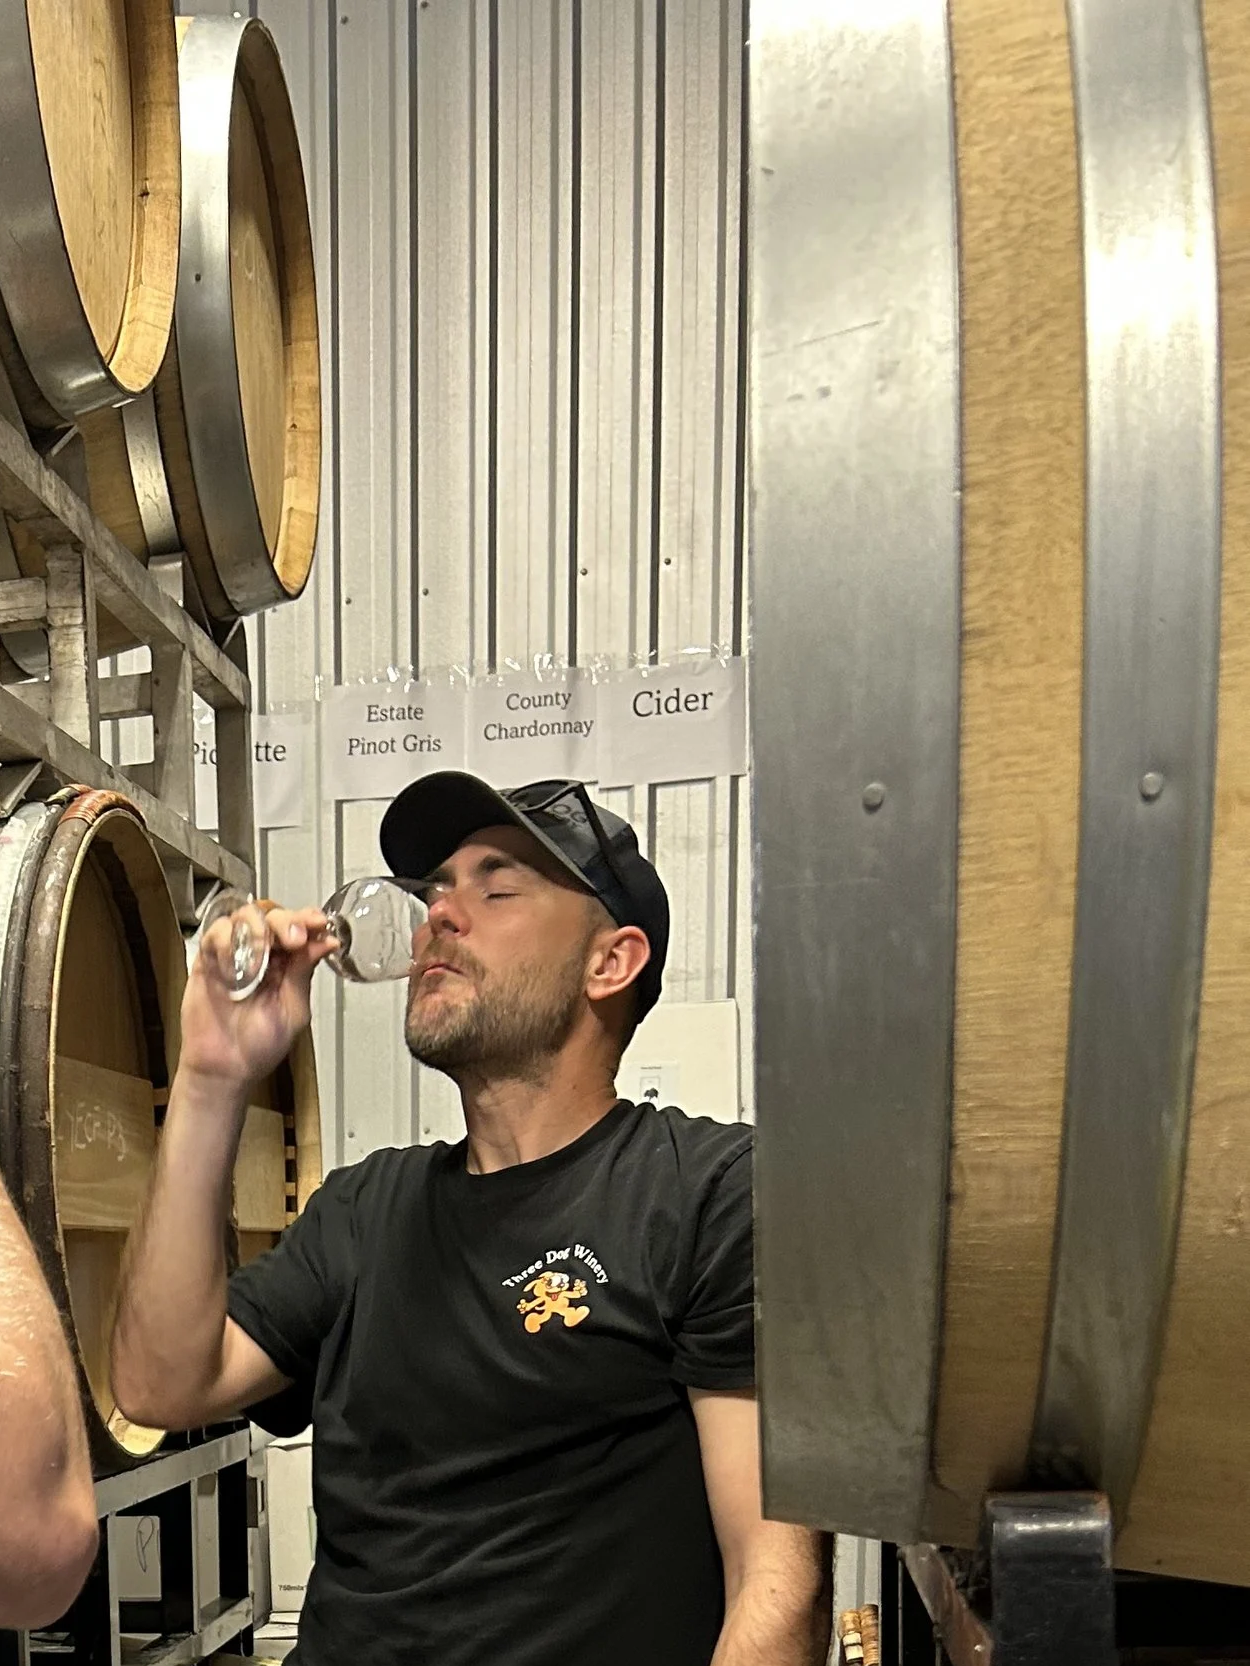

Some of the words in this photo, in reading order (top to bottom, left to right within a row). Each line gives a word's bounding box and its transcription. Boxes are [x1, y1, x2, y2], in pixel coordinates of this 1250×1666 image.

[506, 687, 573, 711] County
[632, 688, 714, 717] Cider
[366, 703, 425, 723] Estate
[483, 718, 595, 742] Chardonnay
[347, 736, 397, 756] Pinot
[402, 733, 442, 754] Gris
[501, 1259, 544, 1289] Three
[545, 1247, 572, 1265] Dog
[573, 1243, 610, 1286] Winery
